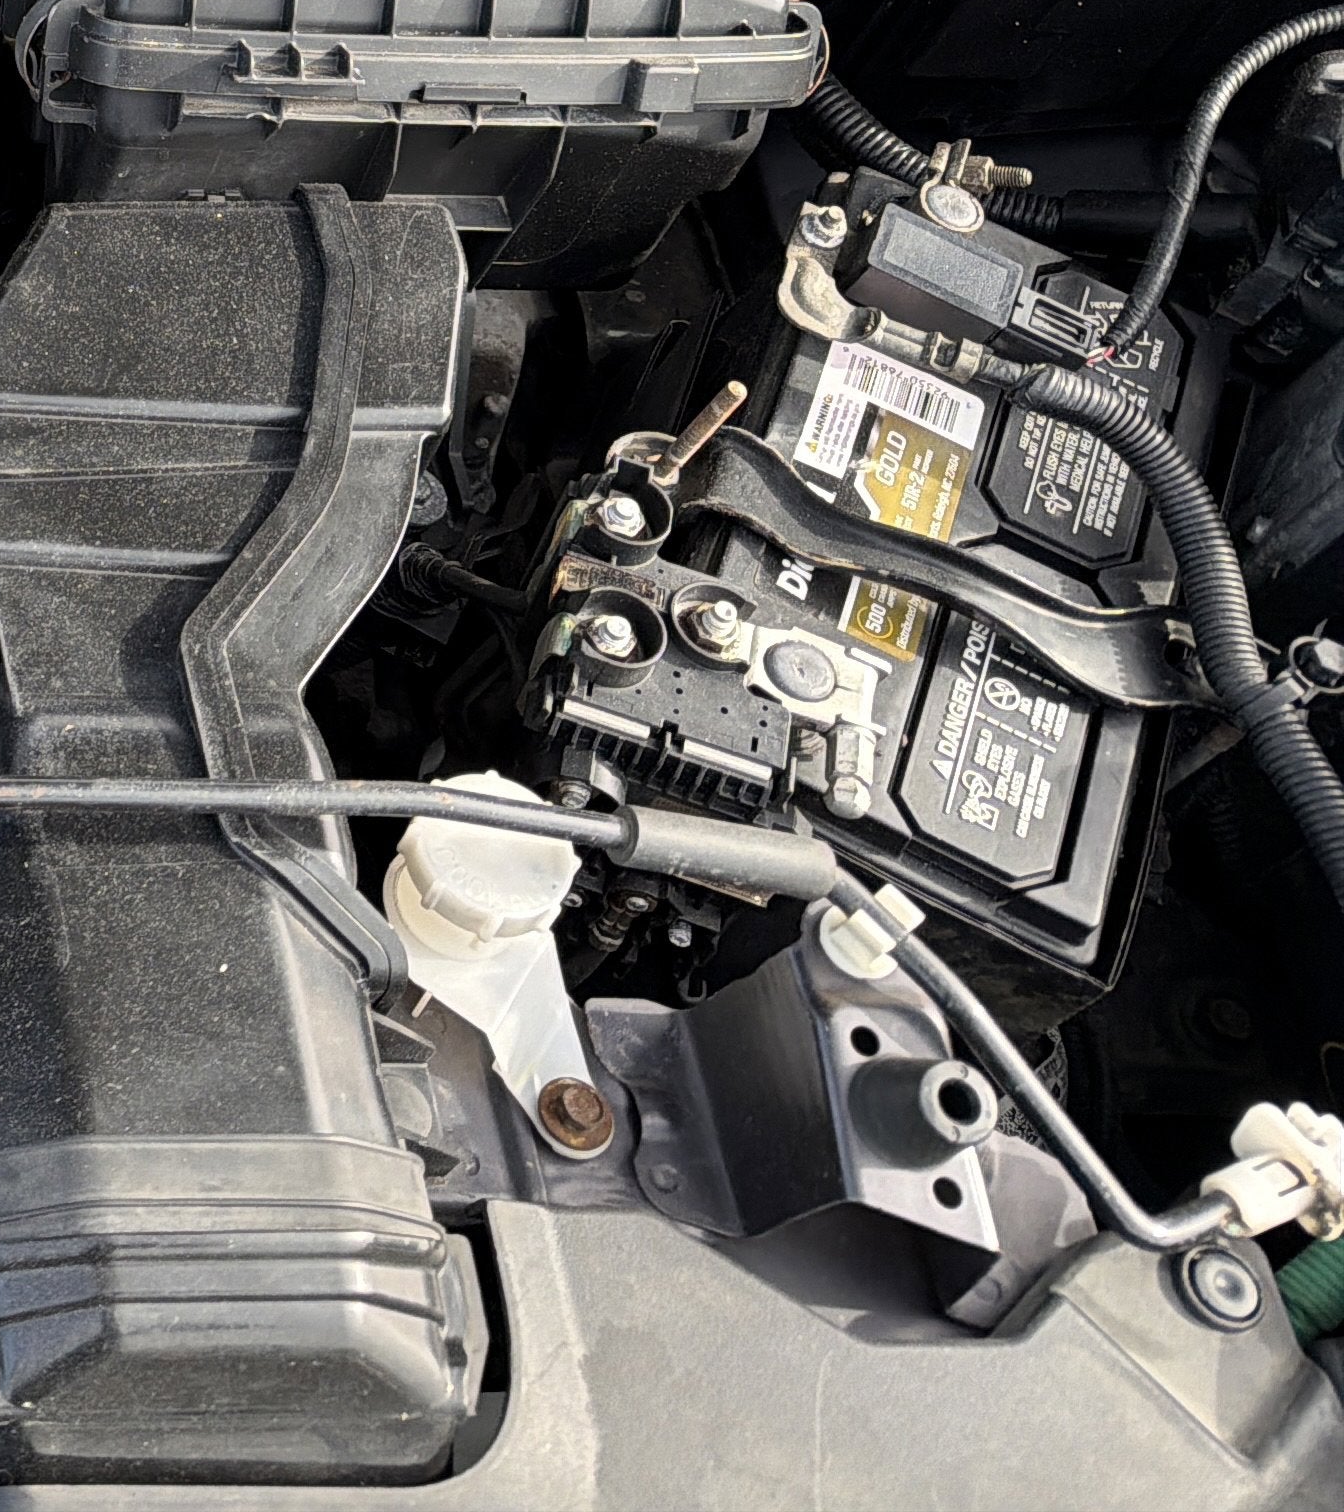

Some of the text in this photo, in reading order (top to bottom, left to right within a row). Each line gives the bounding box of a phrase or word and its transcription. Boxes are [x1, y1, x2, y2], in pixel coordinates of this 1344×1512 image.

[873, 428, 909, 487] GOLD
[1041, 427, 1066, 480] FLUSH EYES
[1055, 461, 1072, 485] WITH
[1067, 453, 1088, 492] MEDICAL
[1094, 461, 1107, 481] SAFE
[899, 469, 927, 511] 51R-2
[1092, 482, 1114, 531] INSTRUCTIONS
[1108, 477, 1126, 515] AVAILABLE
[864, 601, 888, 633] 500
[894, 603, 919, 650] Distributed
[972, 727, 994, 767] SHIELD
[985, 743, 1004, 773] EYES
[992, 744, 1019, 801] EXPLOSIVE
[1006, 769, 1027, 807] GASES
